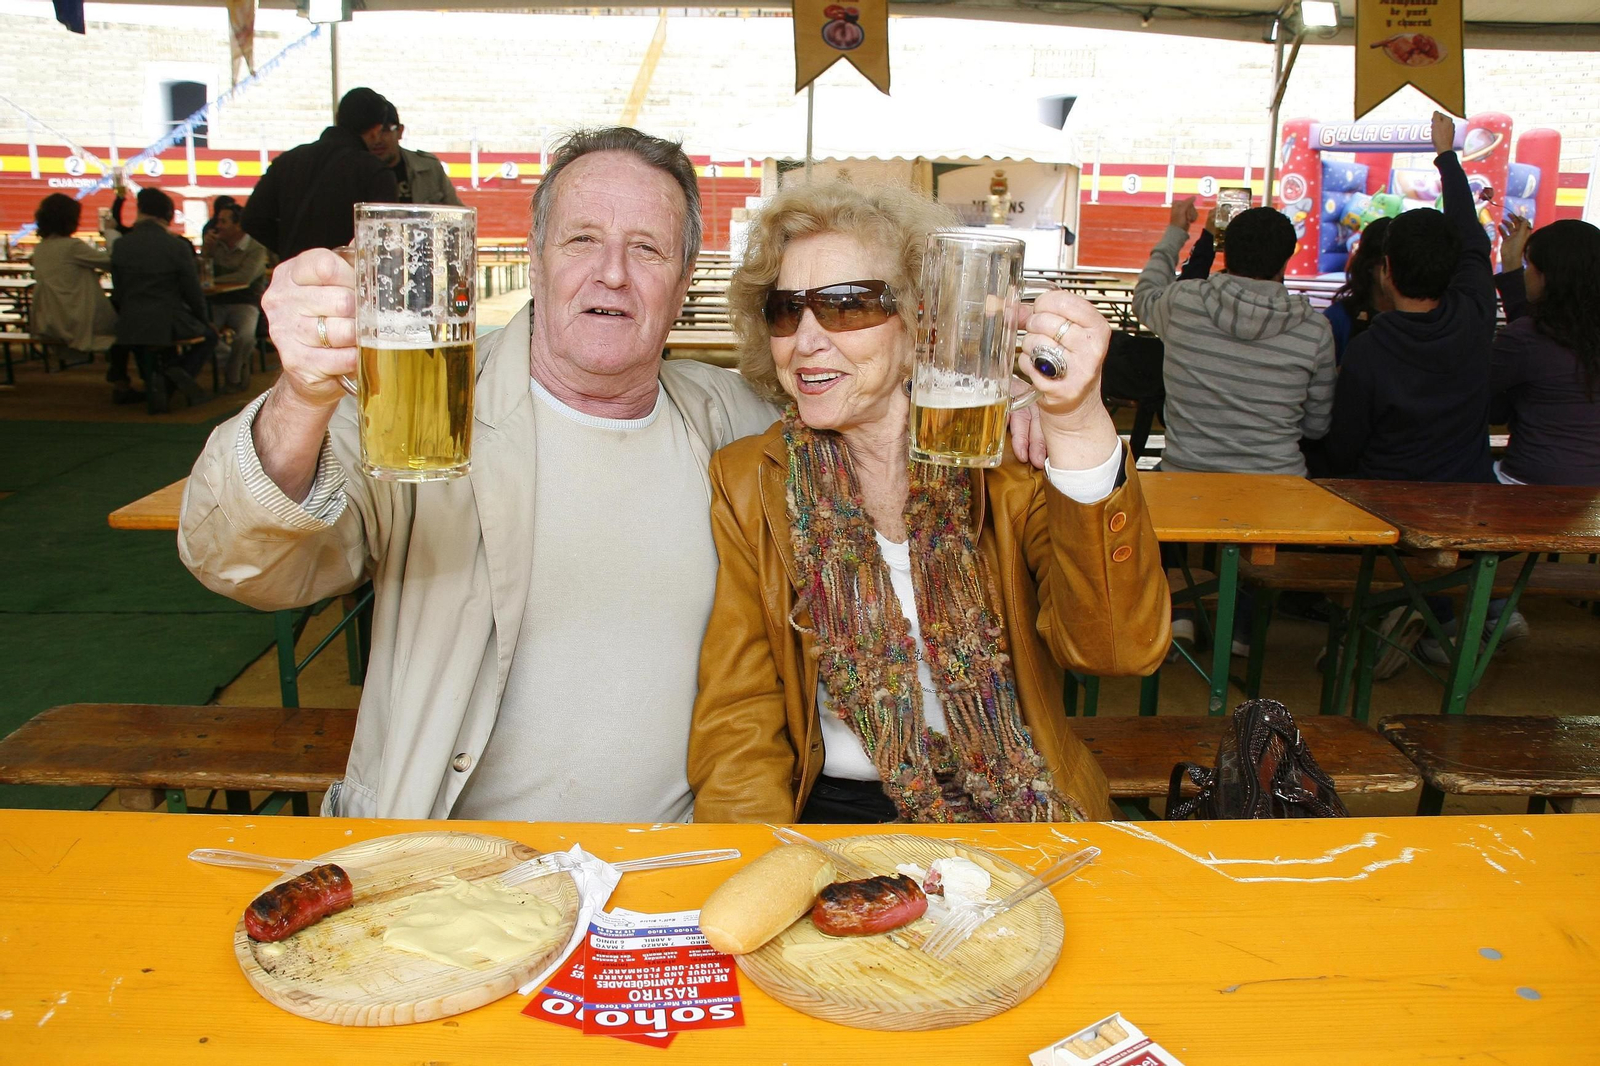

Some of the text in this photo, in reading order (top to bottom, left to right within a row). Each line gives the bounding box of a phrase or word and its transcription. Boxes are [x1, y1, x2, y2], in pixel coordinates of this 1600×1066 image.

[70, 158, 79, 172] 2
[149, 160, 157, 173] 2
[224, 162, 231, 174] 2
[505, 163, 512, 176] 2
[1128, 176, 1136, 192] 3
[1203, 178, 1212, 194] 3
[665, 962, 720, 971] KUNST-UND
[688, 968, 730, 976] ANTIQUE
[596, 978, 675, 989] ANTIGÜEDADES
[687, 975, 711, 985] ARTE
[714, 974, 728, 982] DE
[552, 990, 574, 1000] Toros
[628, 986, 698, 1002] RASTRO
[695, 997, 733, 1005] Roquetas
[594, 1004, 735, 1030] soho
